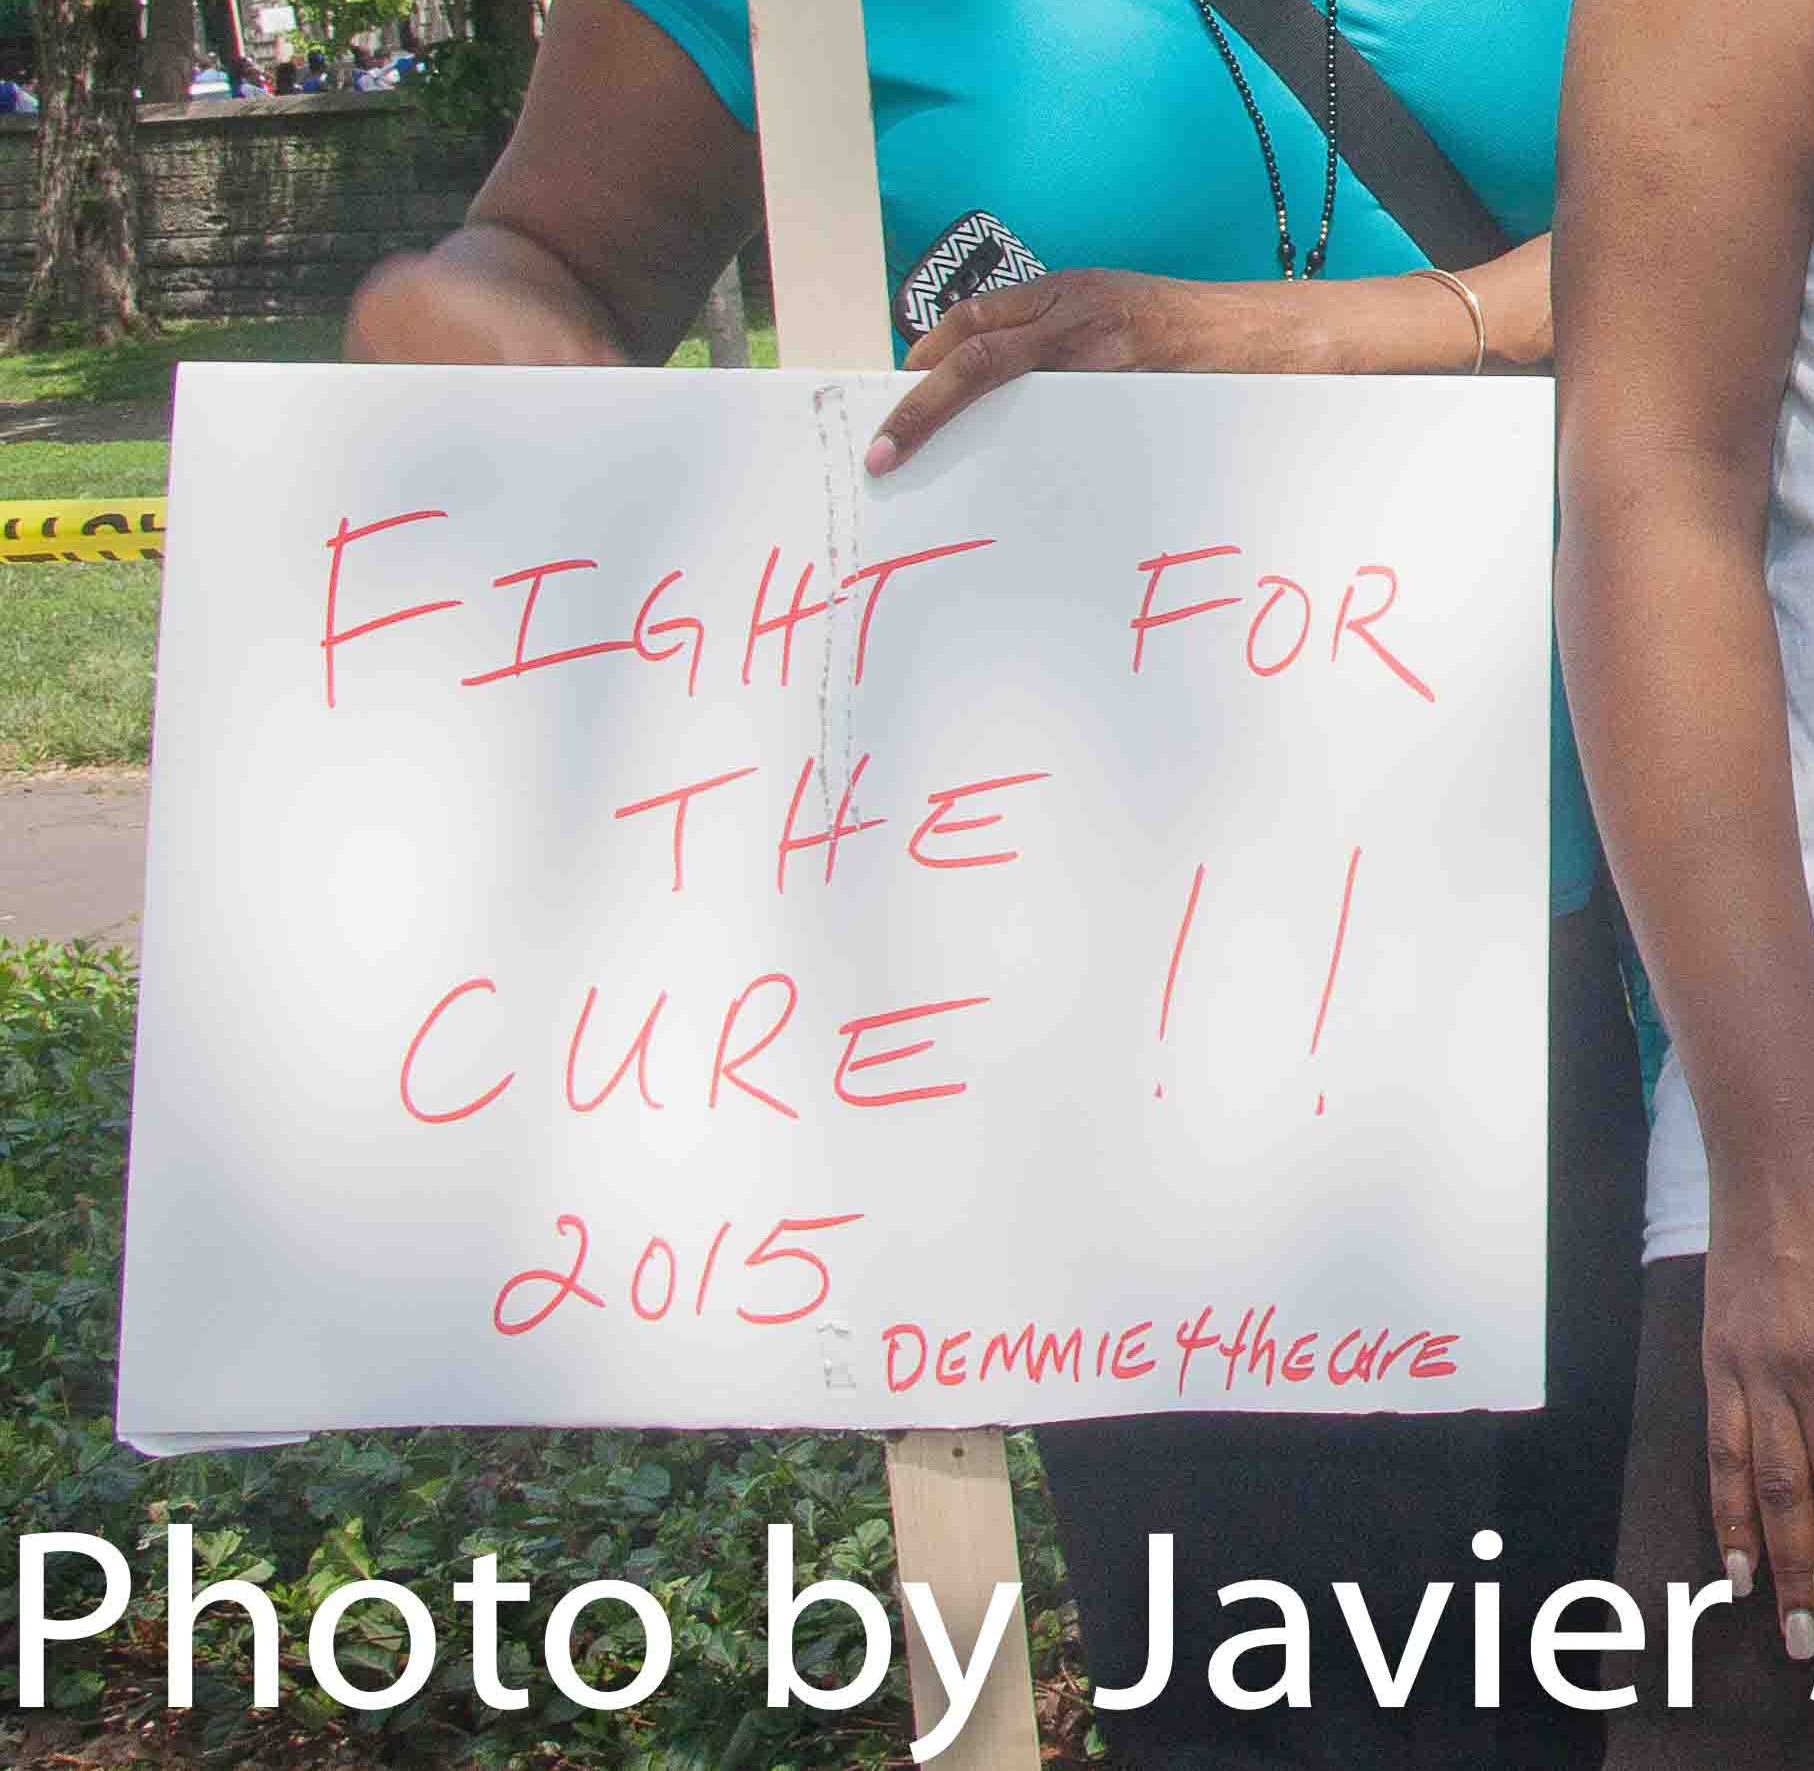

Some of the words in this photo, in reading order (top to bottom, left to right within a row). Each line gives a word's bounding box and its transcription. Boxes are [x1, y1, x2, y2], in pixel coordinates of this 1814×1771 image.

[319, 510, 996, 710] FIGHT
[1130, 544, 1437, 703] FOR
[614, 754, 1052, 894] THE
[399, 972, 993, 1125] CURE
[494, 1213, 867, 1337] 2015
